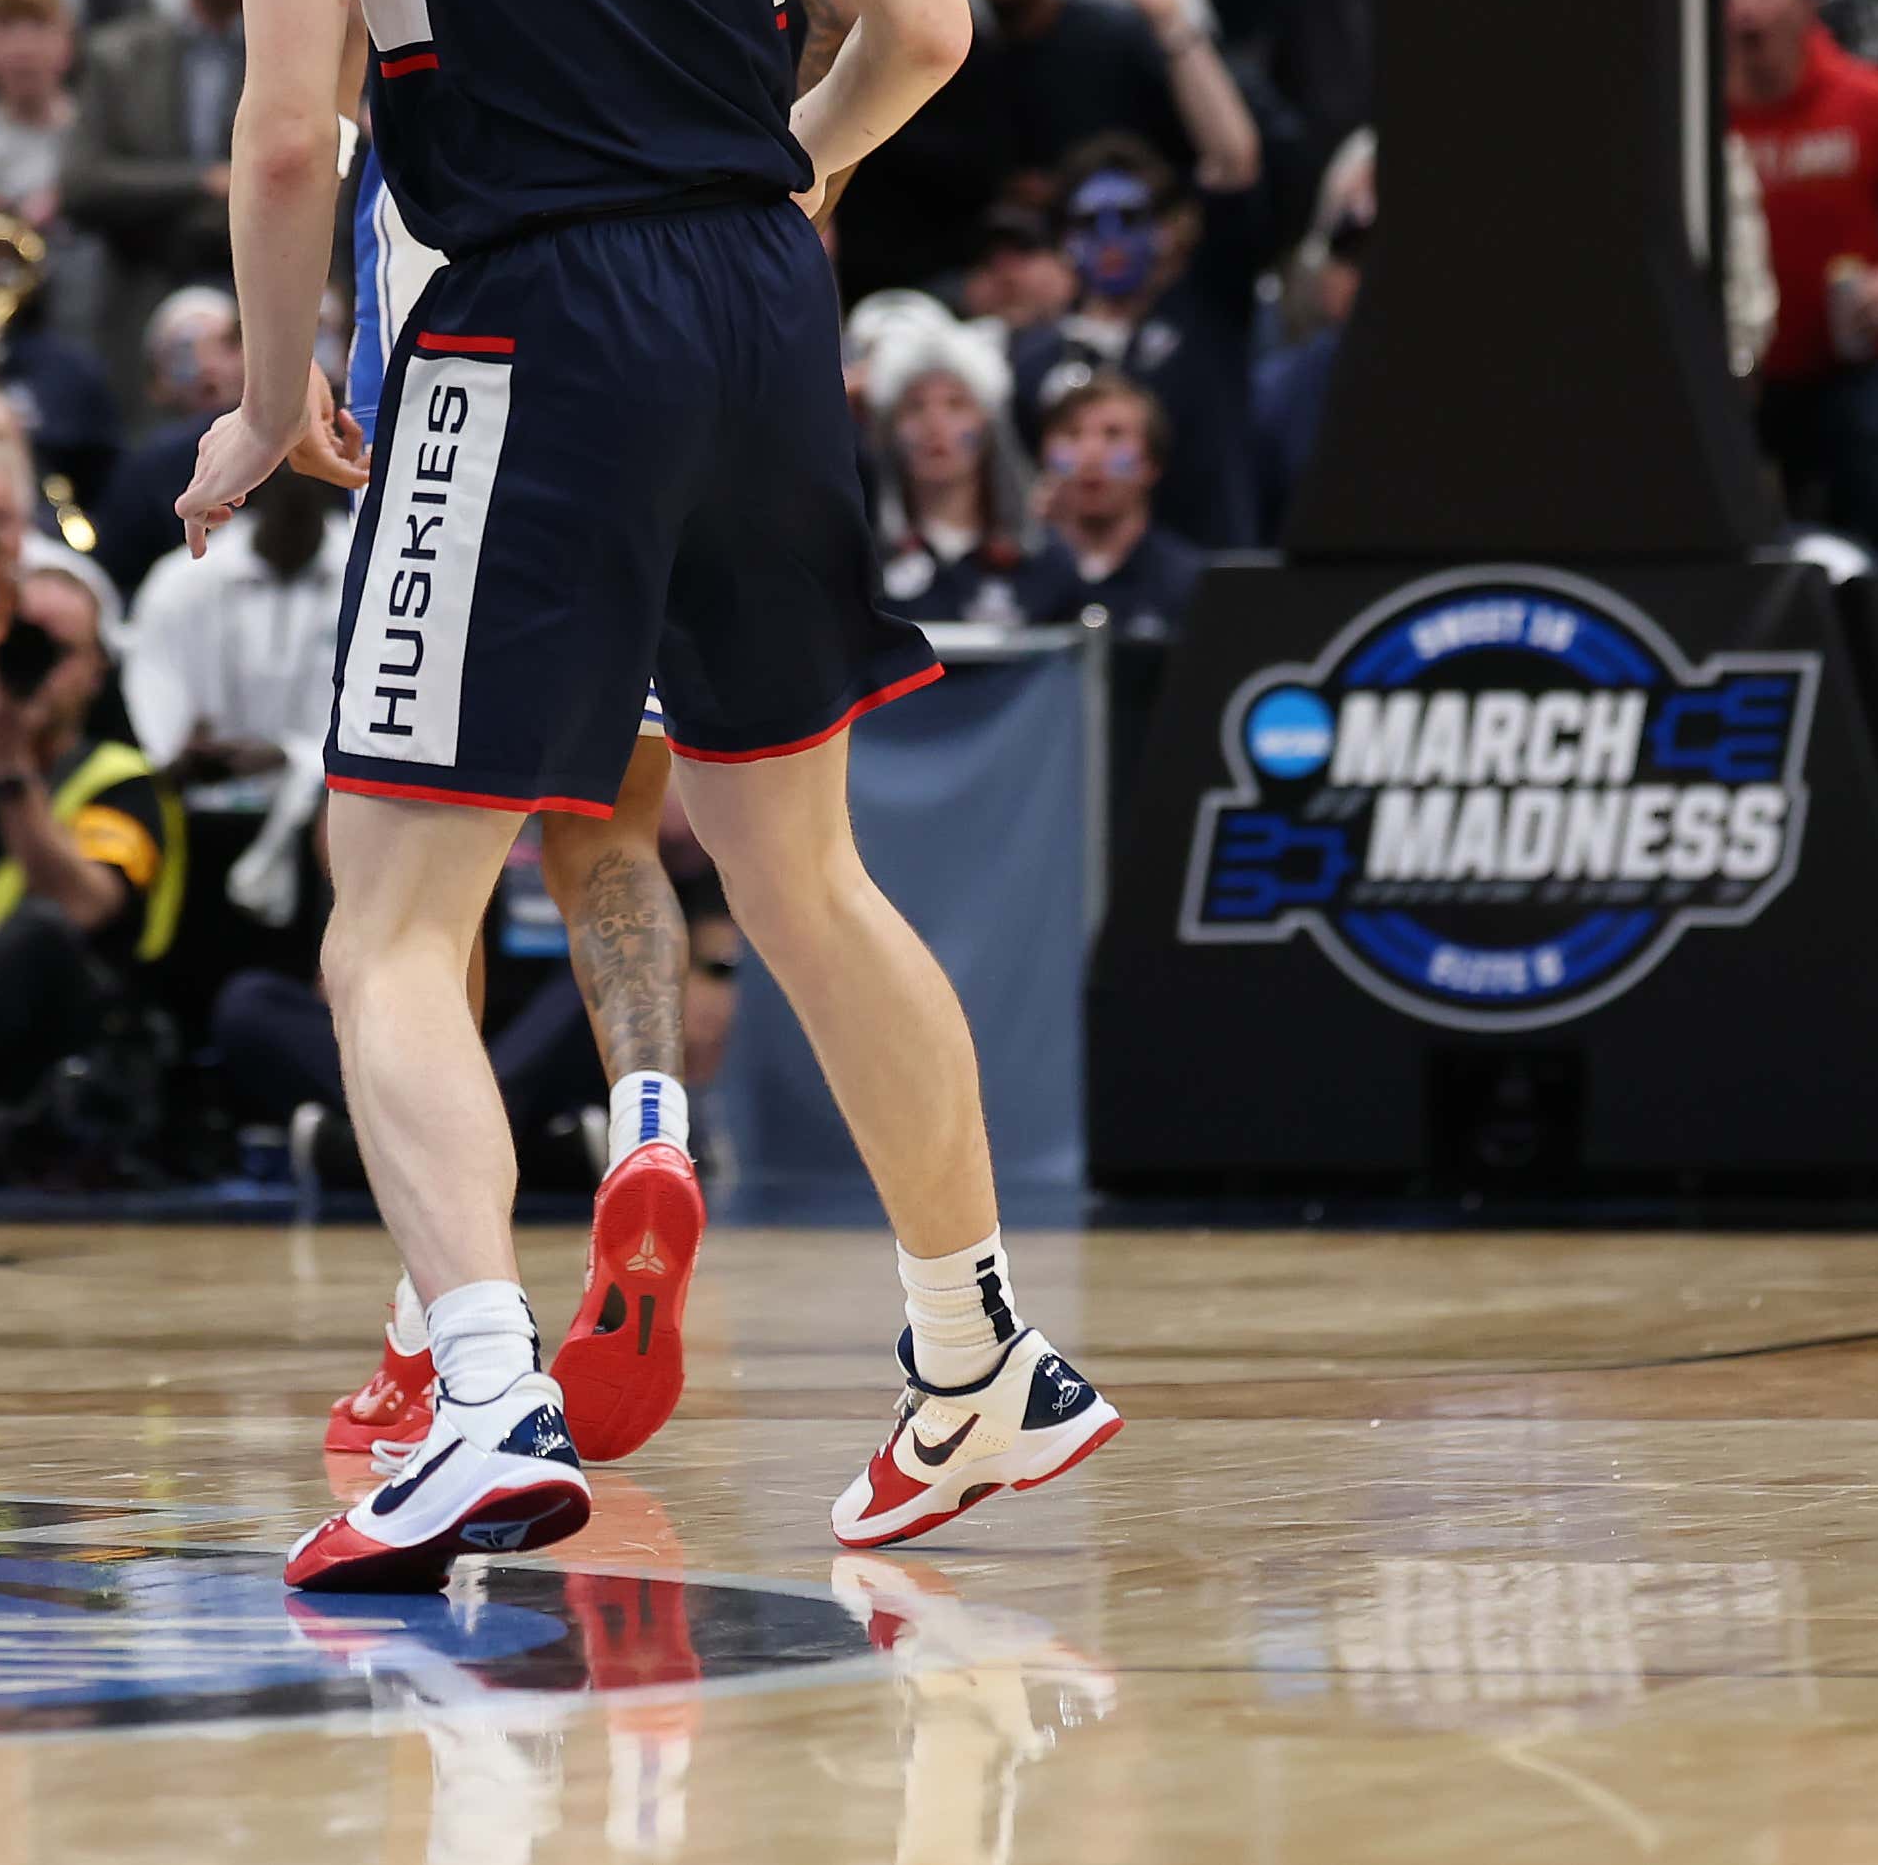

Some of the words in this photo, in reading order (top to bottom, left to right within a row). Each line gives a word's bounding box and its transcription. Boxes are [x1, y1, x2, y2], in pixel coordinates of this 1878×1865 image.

[368, 384, 469, 737] HUSKIES
[1330, 689, 1648, 786] MARCH
[1365, 784, 1788, 881] MADNESS
